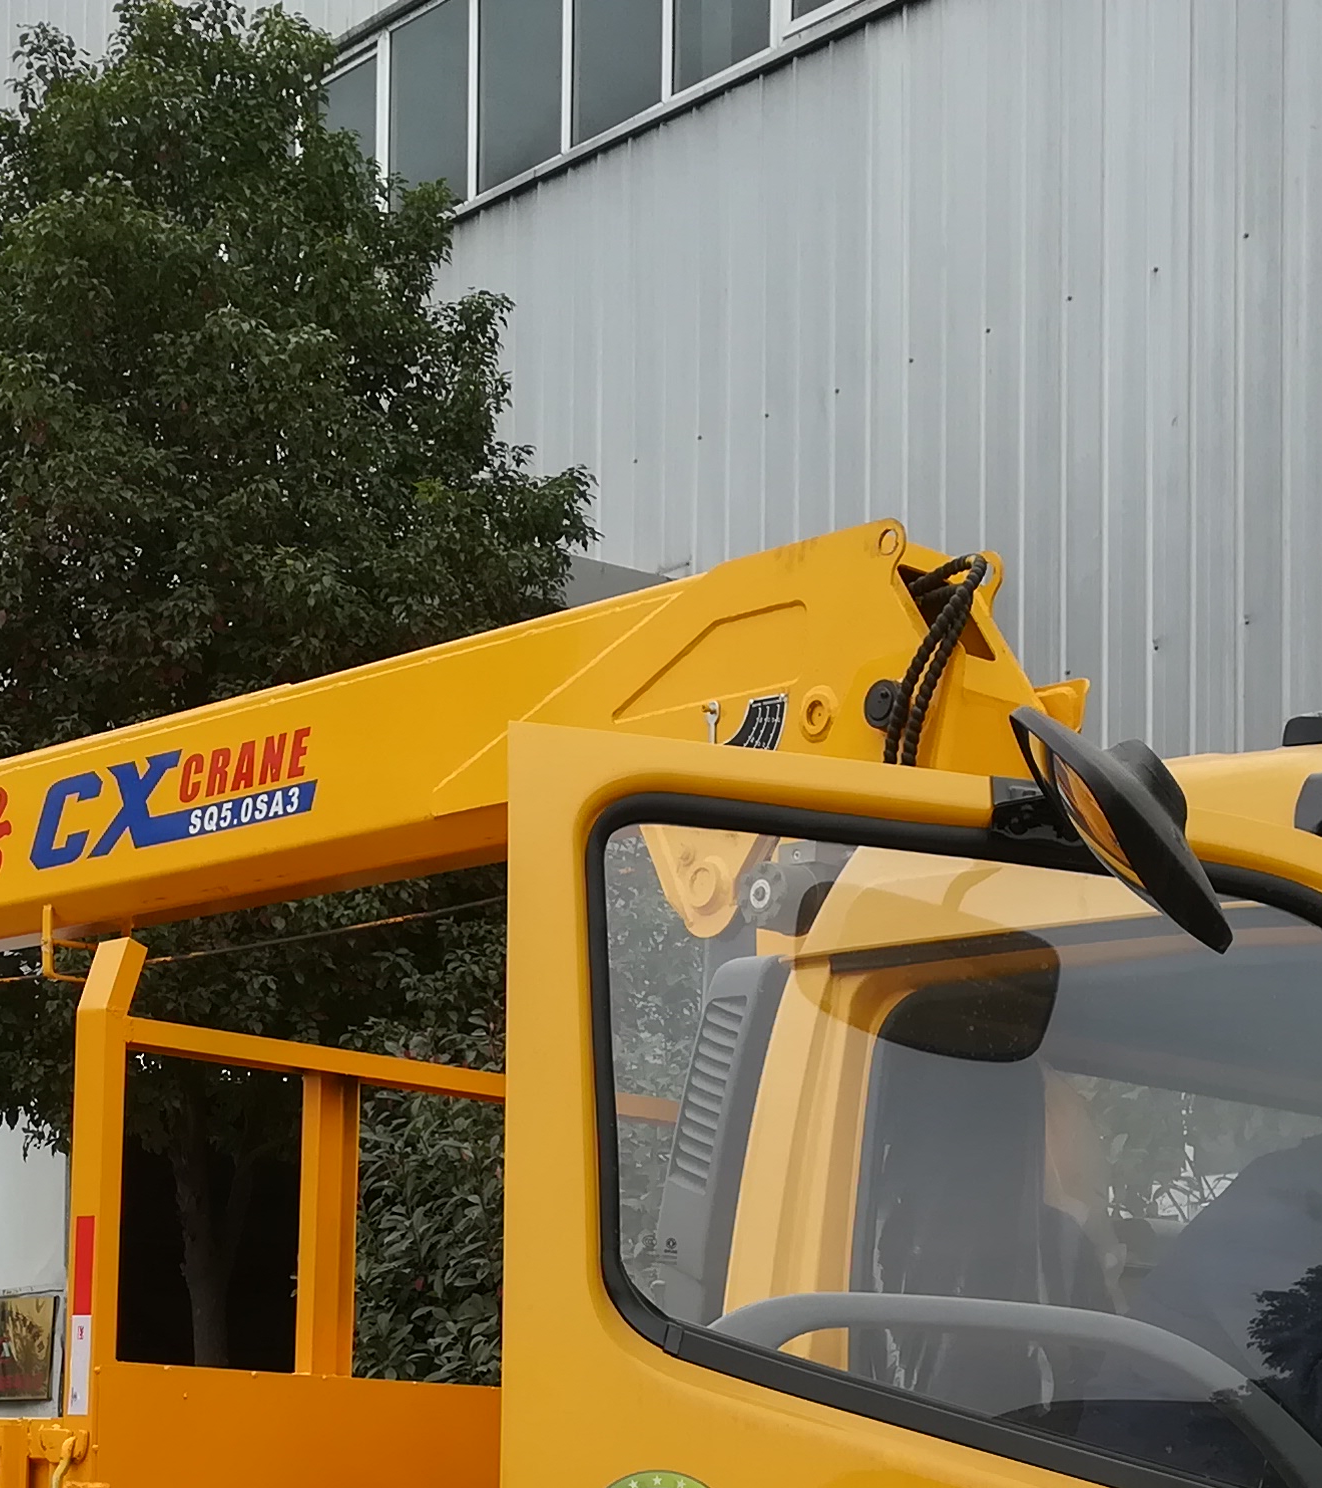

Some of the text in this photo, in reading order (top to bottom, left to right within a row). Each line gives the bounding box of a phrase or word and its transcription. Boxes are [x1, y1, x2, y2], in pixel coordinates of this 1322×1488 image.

[179, 727, 311, 803] CRANE
[29, 749, 183, 870] CX
[188, 786, 300, 834] SQ5.0SA3
